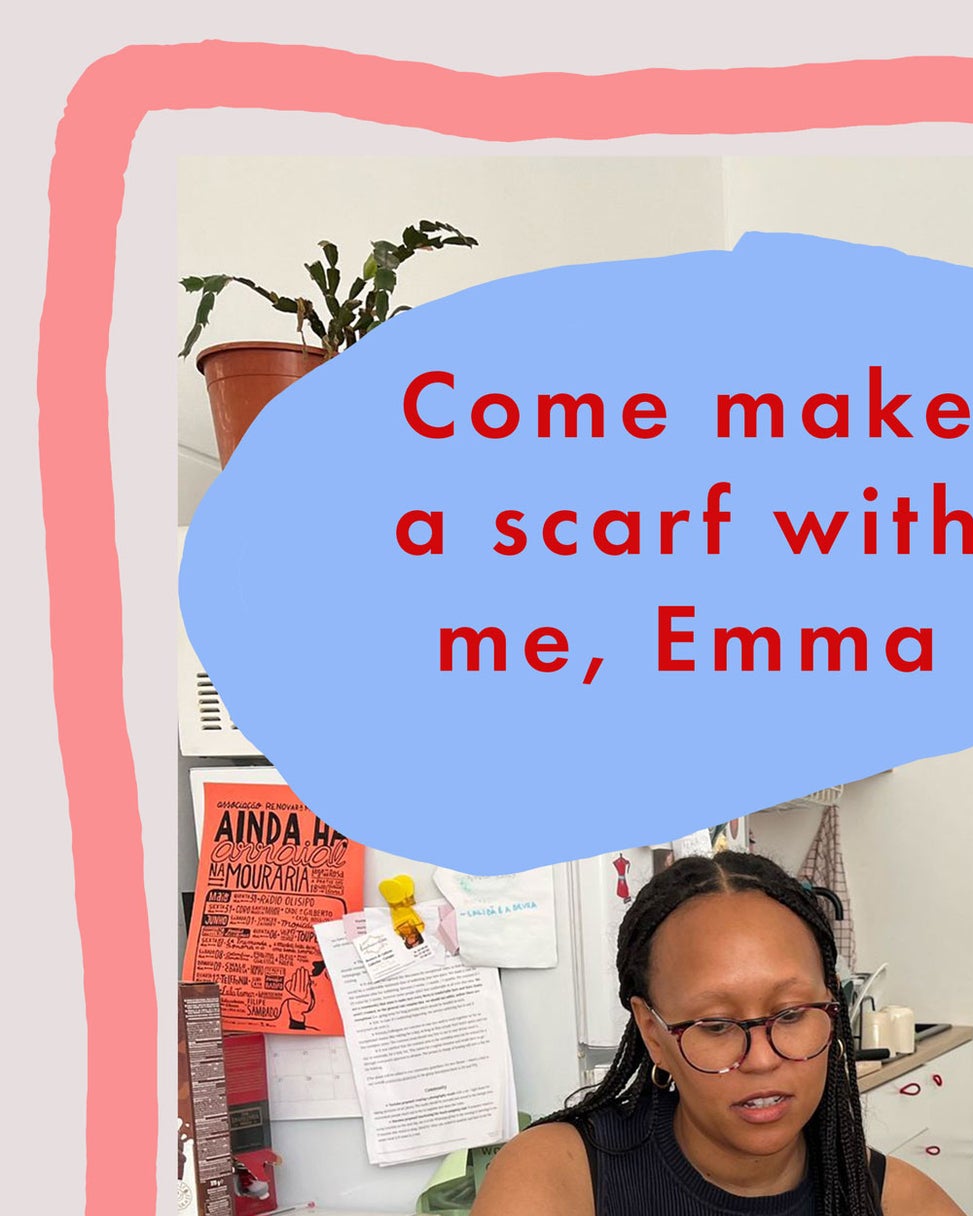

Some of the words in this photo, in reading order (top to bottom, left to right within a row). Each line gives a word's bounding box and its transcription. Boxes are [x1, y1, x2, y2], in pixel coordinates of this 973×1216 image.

[214, 810, 301, 846] AINDA
[210, 839, 349, 868] arraial
[209, 863, 225, 877] NA
[224, 863, 310, 892] MOURARIA
[285, 897, 315, 907] OLISIPO
